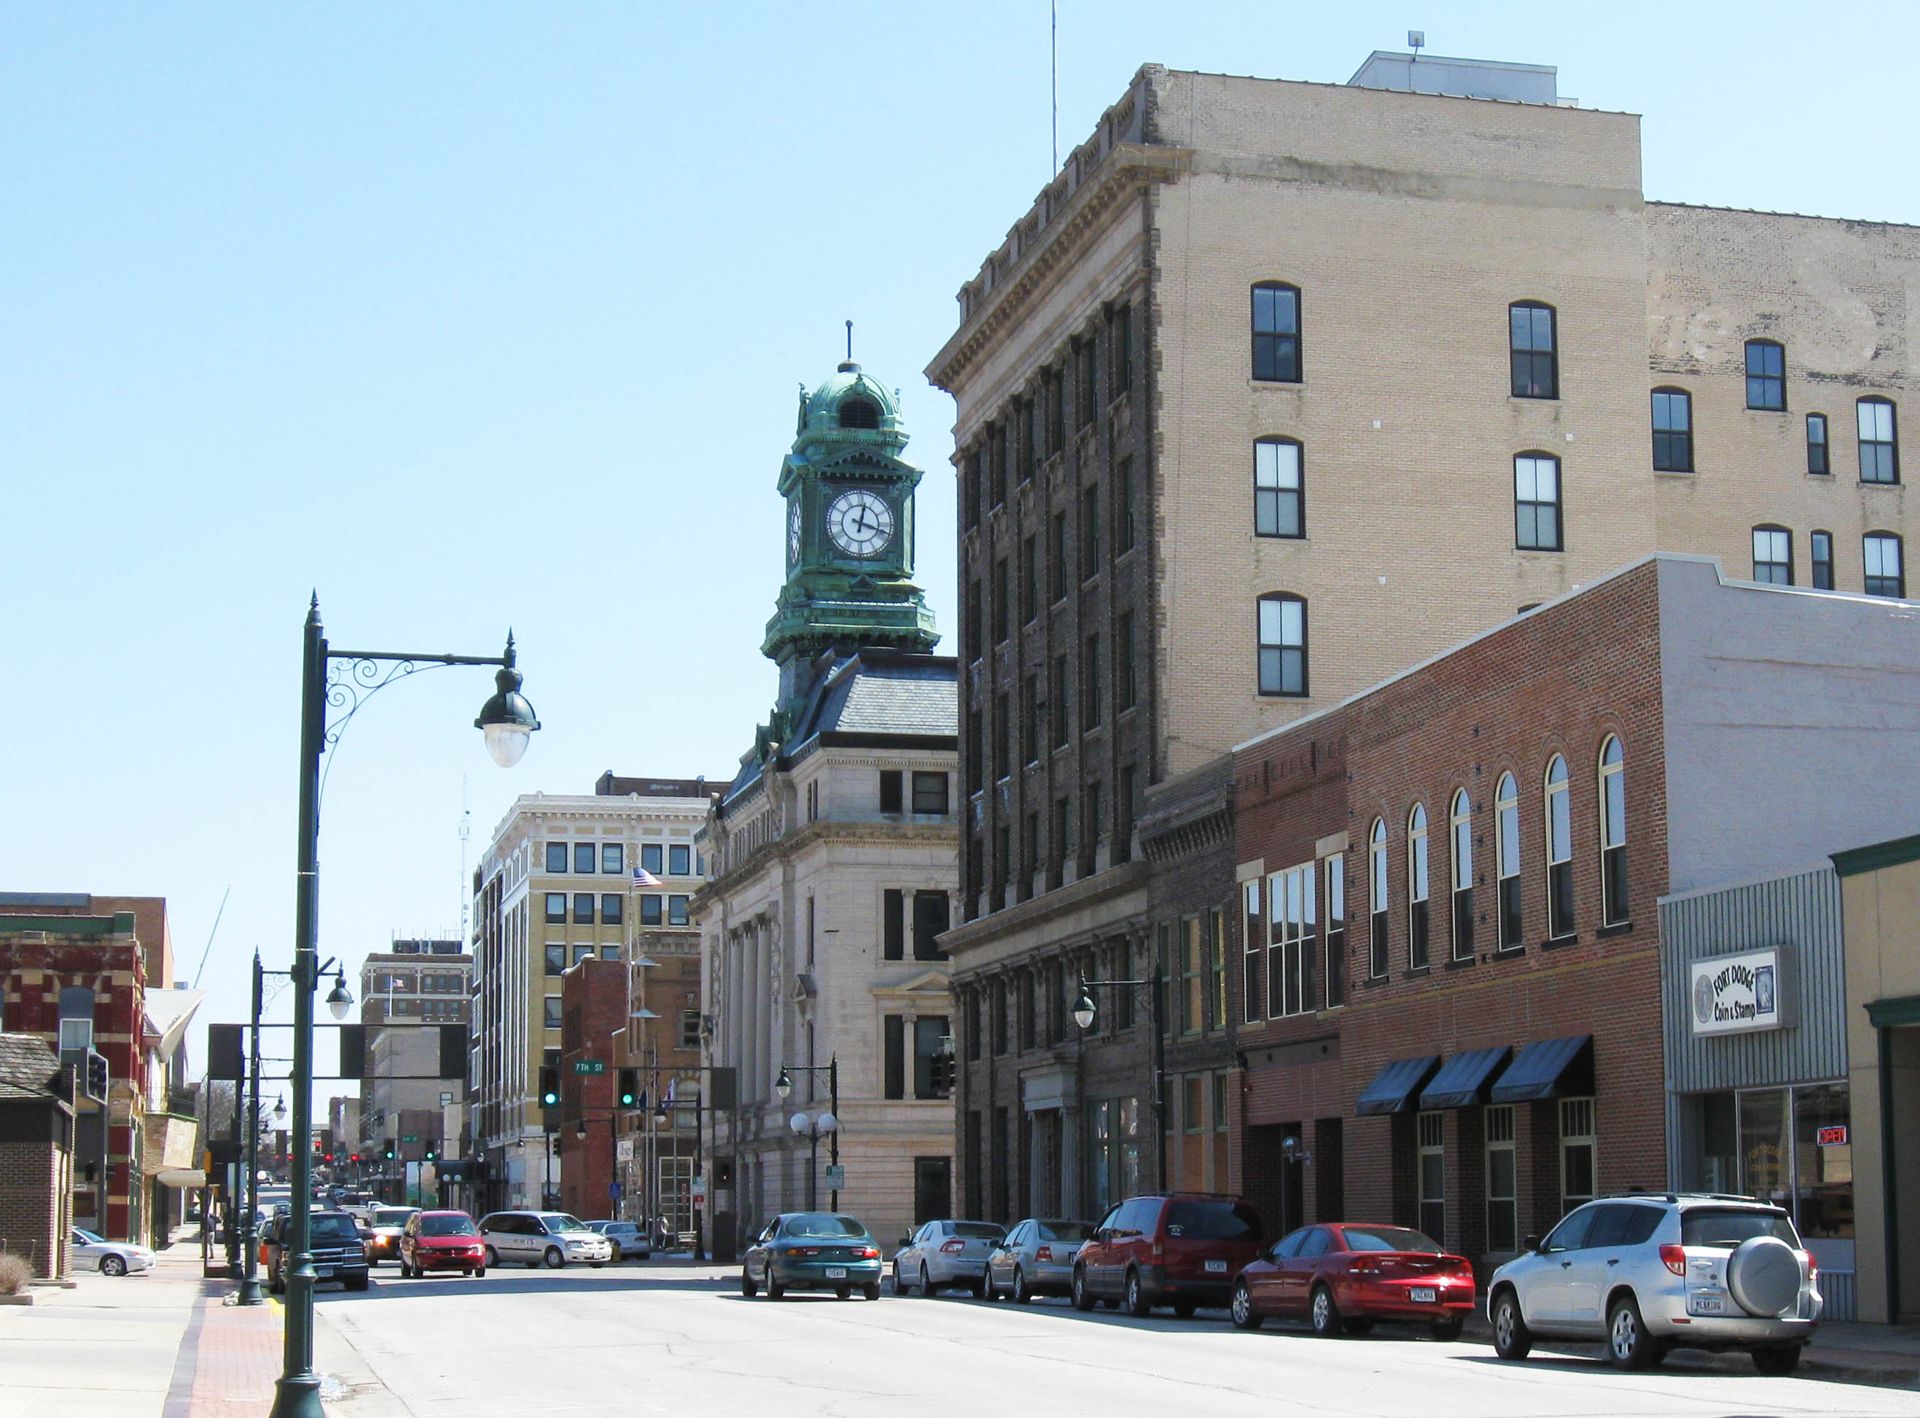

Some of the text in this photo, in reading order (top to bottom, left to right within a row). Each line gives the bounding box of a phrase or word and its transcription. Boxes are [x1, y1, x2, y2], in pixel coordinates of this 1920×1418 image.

[1713, 965, 1755, 997] FORT DODGE
[1714, 1002, 1729, 1022] Coin
[1734, 1000, 1756, 1021] Stamp
[575, 1063, 603, 1072] 7TH ST
[1819, 1128, 1845, 1144] OPEN
